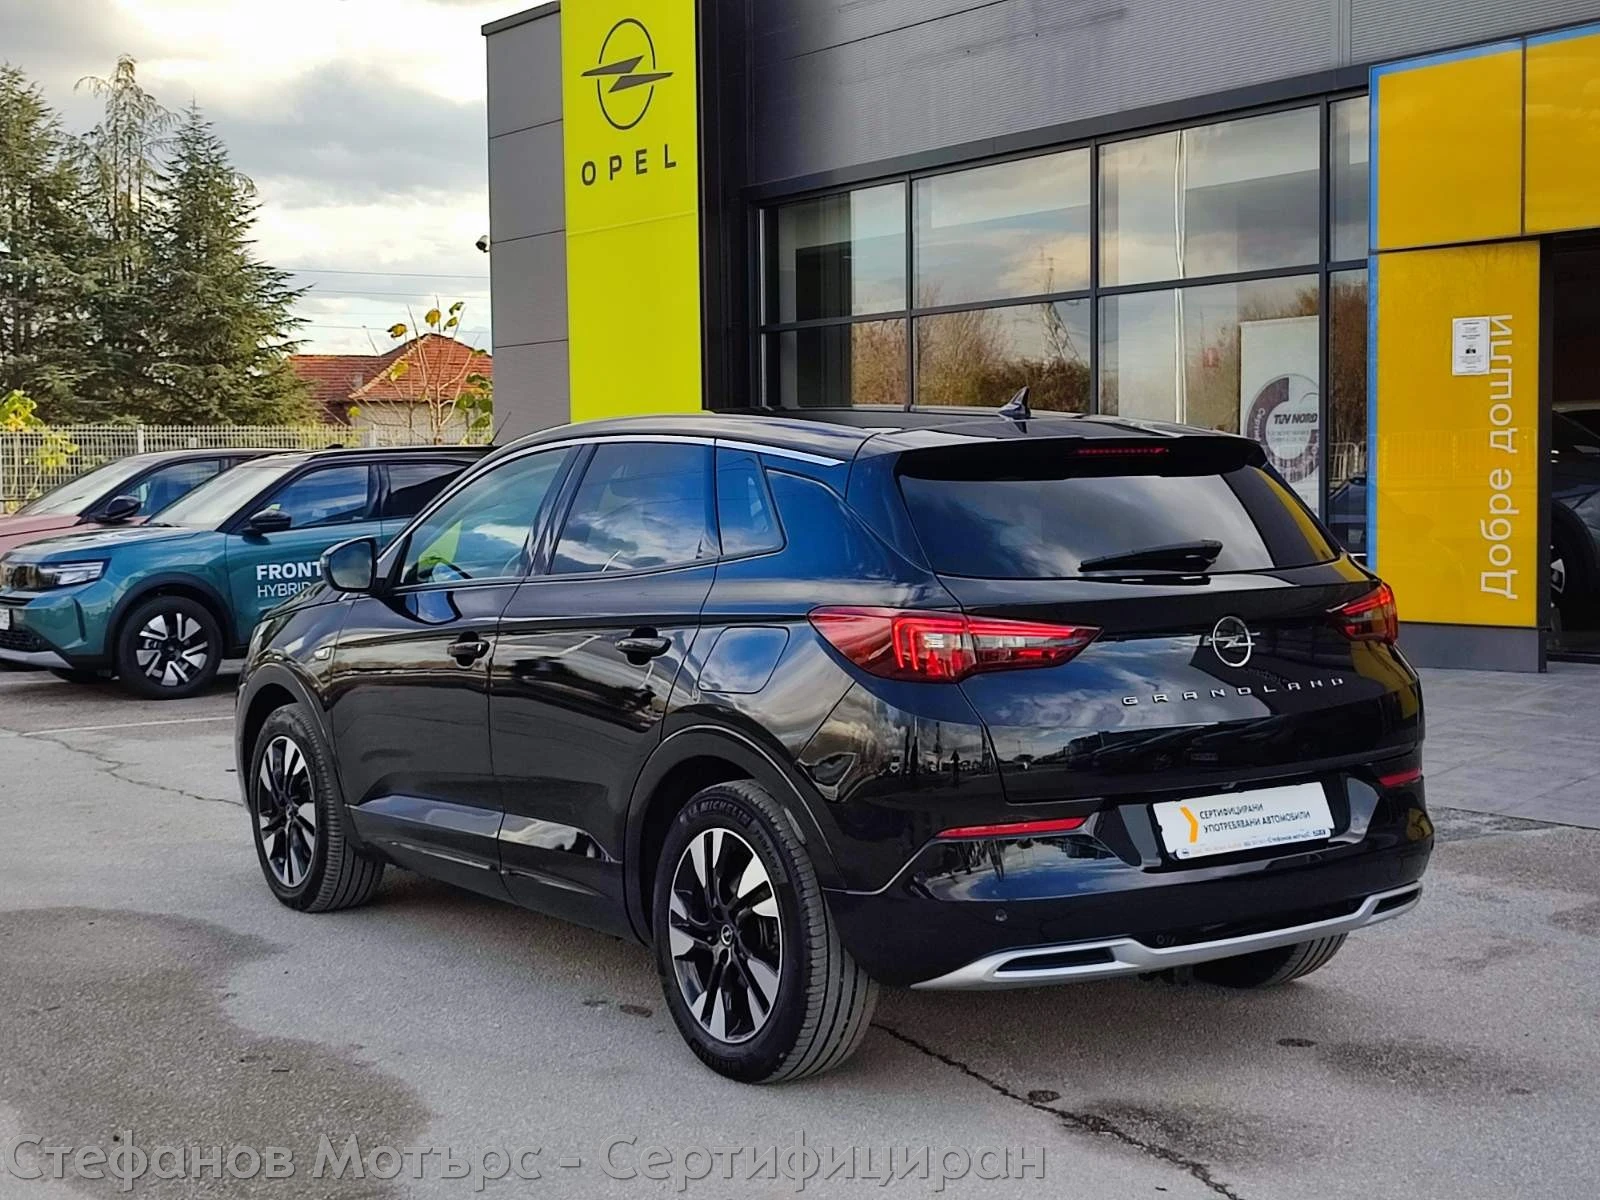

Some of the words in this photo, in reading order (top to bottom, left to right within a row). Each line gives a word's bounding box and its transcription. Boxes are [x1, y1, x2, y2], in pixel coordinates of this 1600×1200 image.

[580, 143, 677, 187] OPEL
[1488, 314, 1518, 454] дошли
[1273, 413, 1292, 425] TÜV
[1291, 412, 1318, 424] NORD
[1480, 468, 1520, 600] Добре
[1122, 677, 1345, 705] GRANDLAND
[1199, 803, 1264, 820] СЕРТИФИЦИРАНИ
[1203, 816, 1262, 834] УПОТРЕБЯВАНИ
[1261, 809, 1311, 825] АВТОМОБИЛИ
